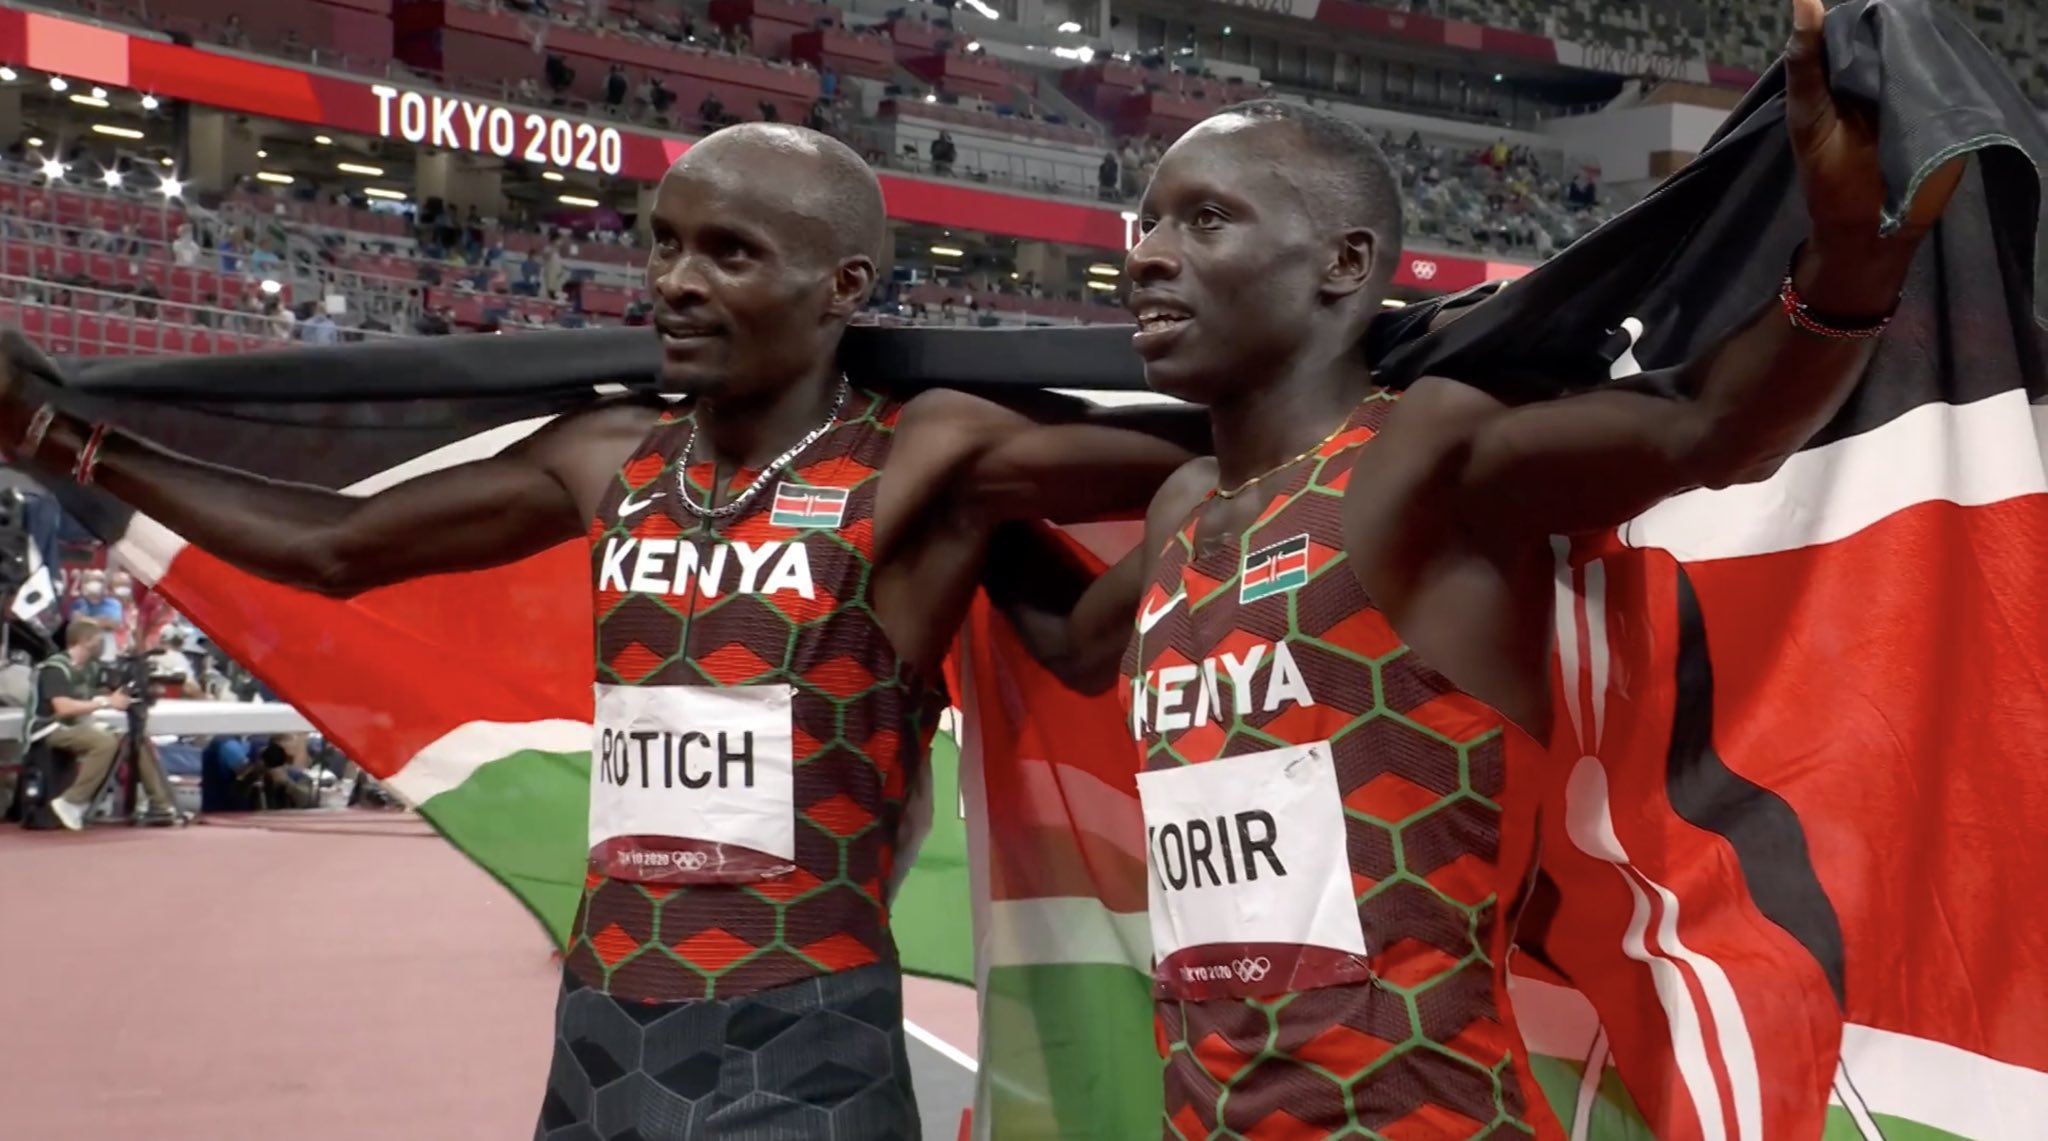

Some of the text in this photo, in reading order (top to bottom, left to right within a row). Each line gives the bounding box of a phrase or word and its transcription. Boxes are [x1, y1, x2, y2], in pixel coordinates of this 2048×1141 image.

[371, 84, 622, 175] TOKYO 2020
[600, 538, 815, 600] KENYA
[601, 728, 754, 789] ROTICH
[644, 853, 670, 866] 2020
